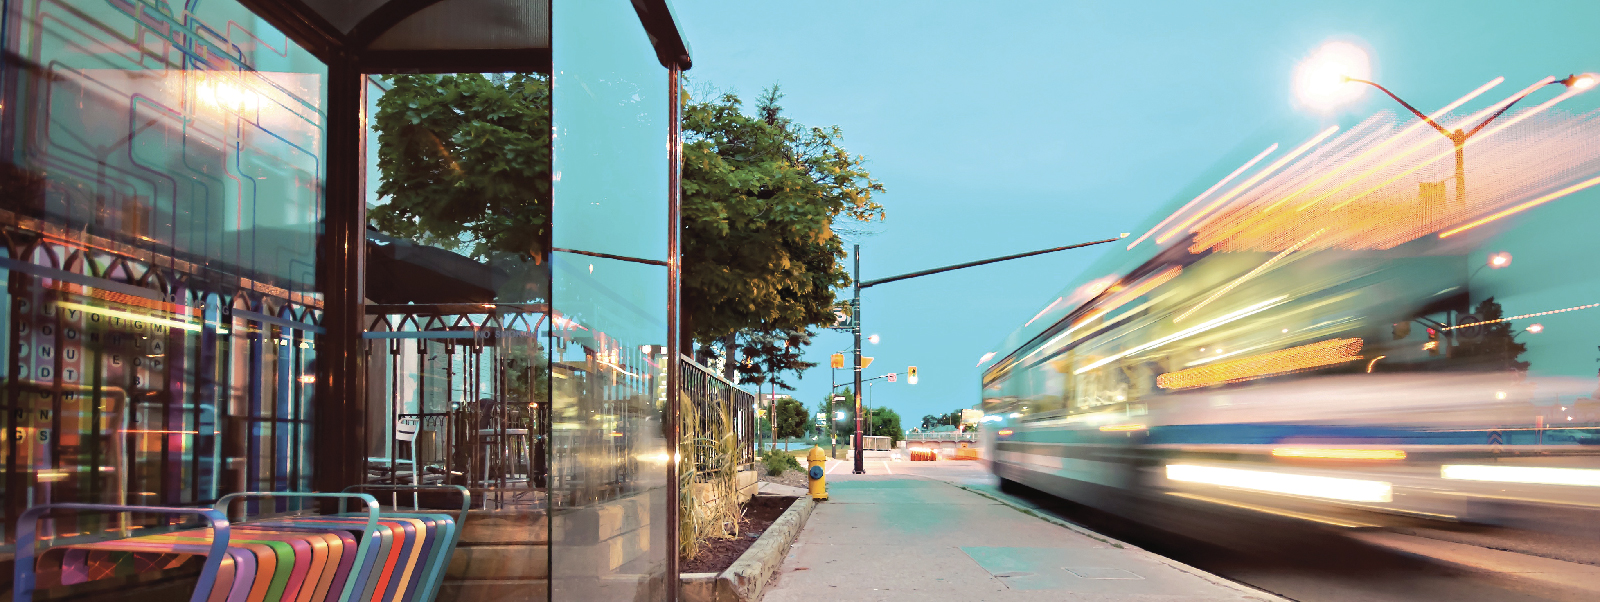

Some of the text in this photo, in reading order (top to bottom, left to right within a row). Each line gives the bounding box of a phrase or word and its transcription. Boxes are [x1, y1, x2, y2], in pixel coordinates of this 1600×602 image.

[14, 300, 27, 441] PUTTNG
[65, 308, 76, 400] YOUTH
[133, 320, 143, 423] GLOBL
[154, 324, 162, 367] MAP
[495, 330, 536, 339] SMOK
